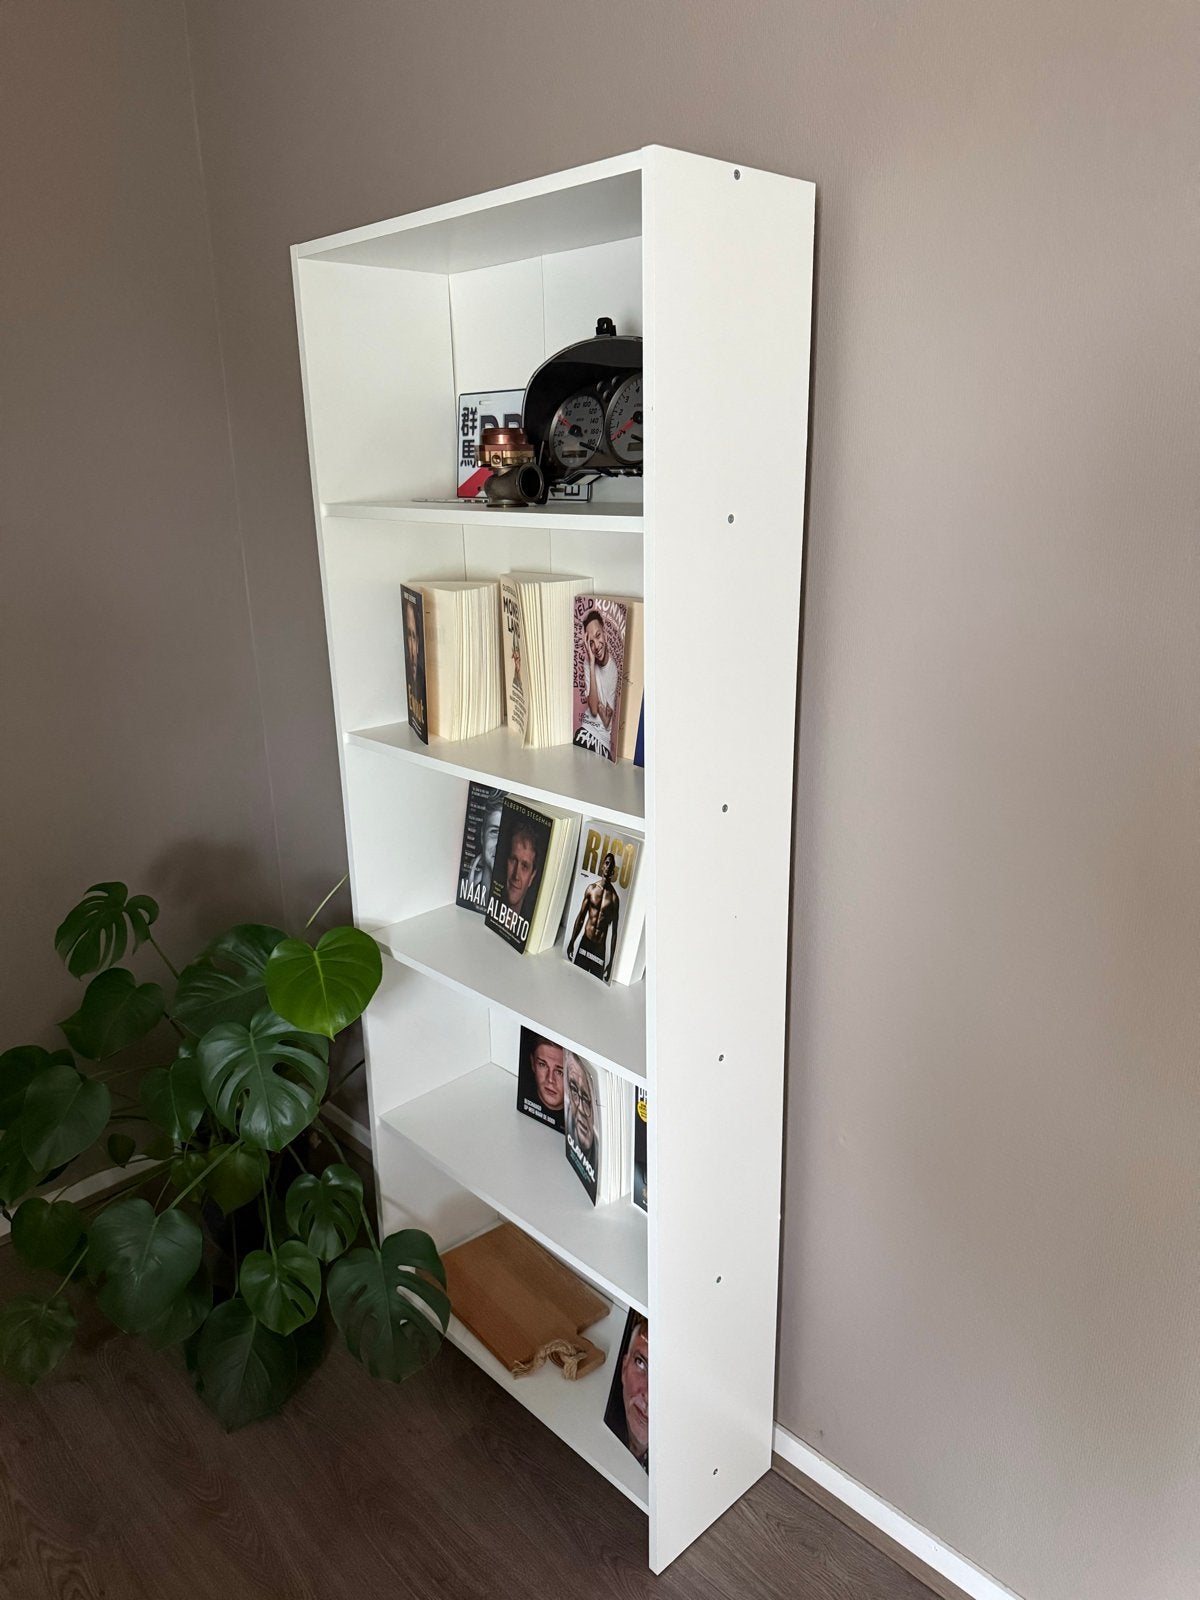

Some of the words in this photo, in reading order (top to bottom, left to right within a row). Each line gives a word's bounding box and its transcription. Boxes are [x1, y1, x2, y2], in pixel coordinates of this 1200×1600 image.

[504, 800, 526, 814] ALBERTO
[582, 829, 635, 890] RICO
[459, 878, 487, 907] NAAR
[487, 896, 530, 942] ALBERTO
